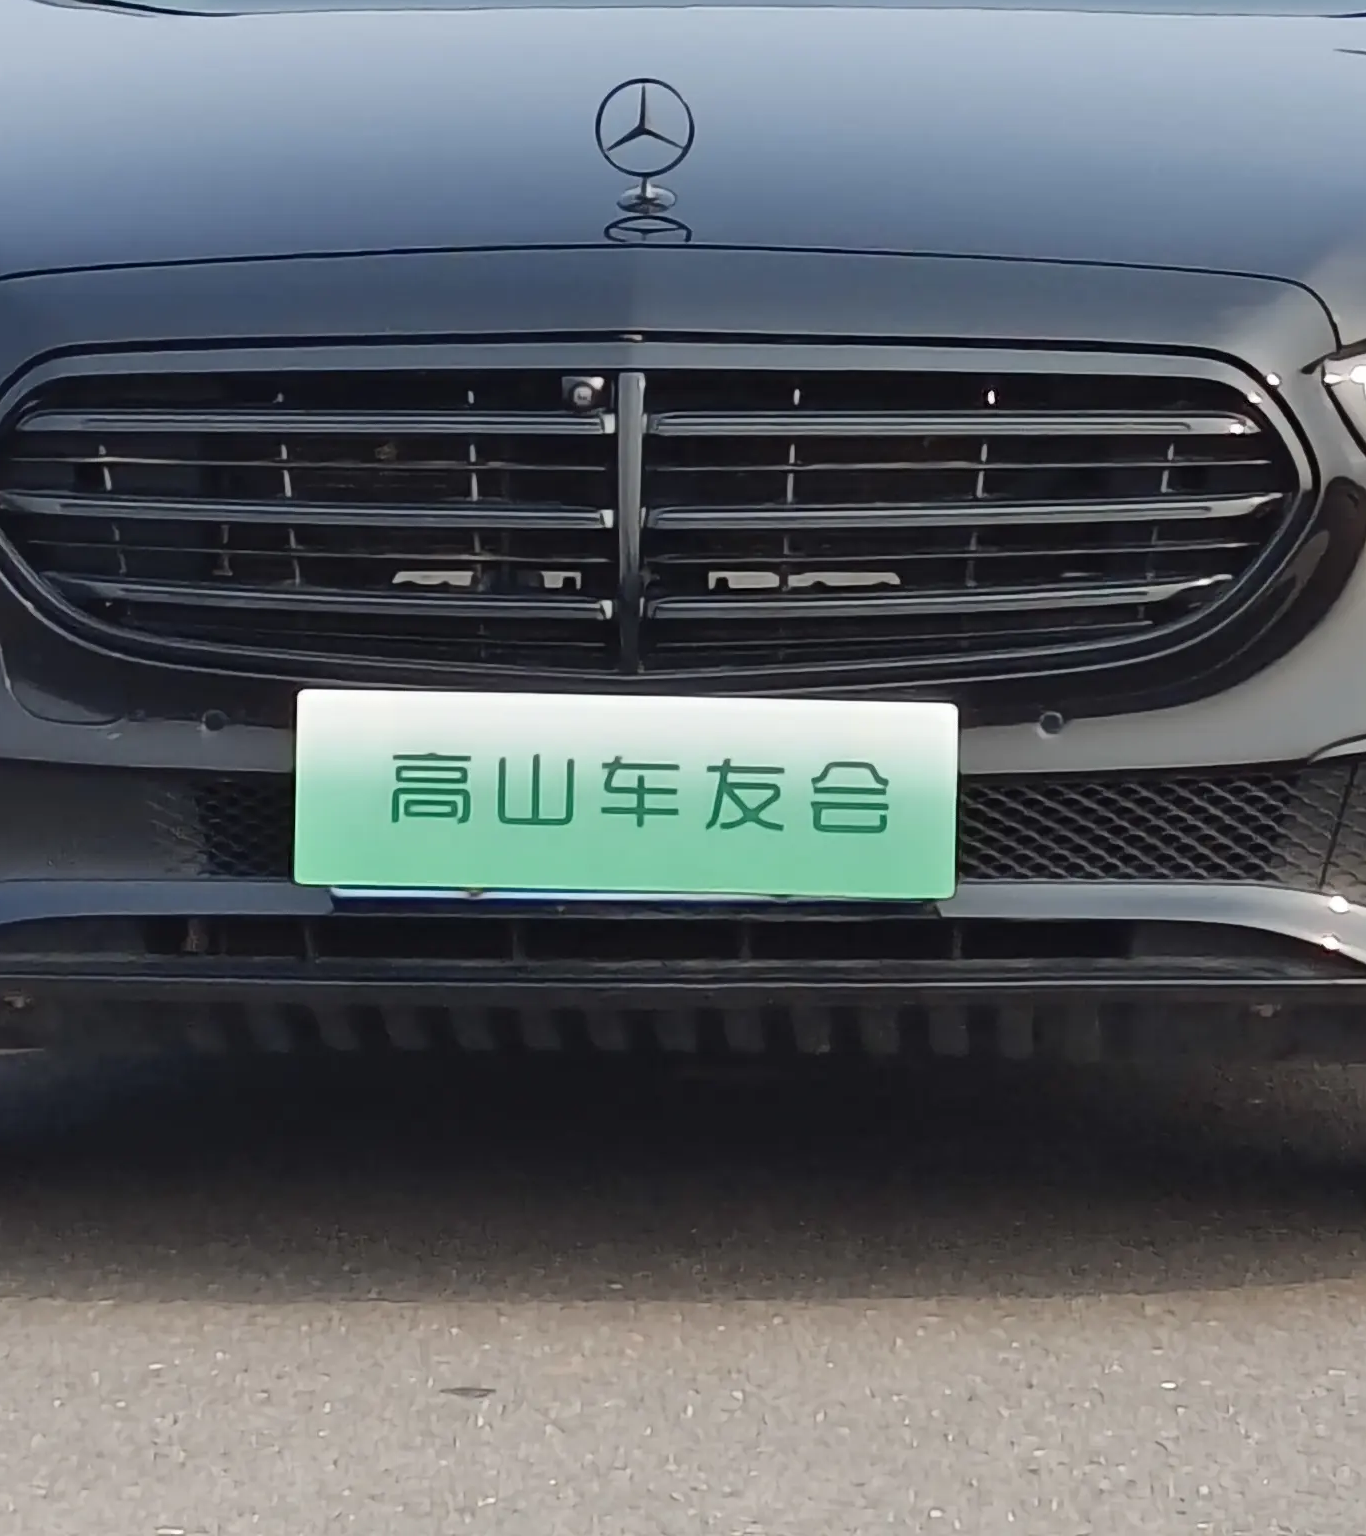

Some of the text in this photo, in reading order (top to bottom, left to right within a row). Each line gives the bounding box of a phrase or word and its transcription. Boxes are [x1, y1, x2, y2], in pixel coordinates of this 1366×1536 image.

[391, 752, 889, 834] 高山车友会
